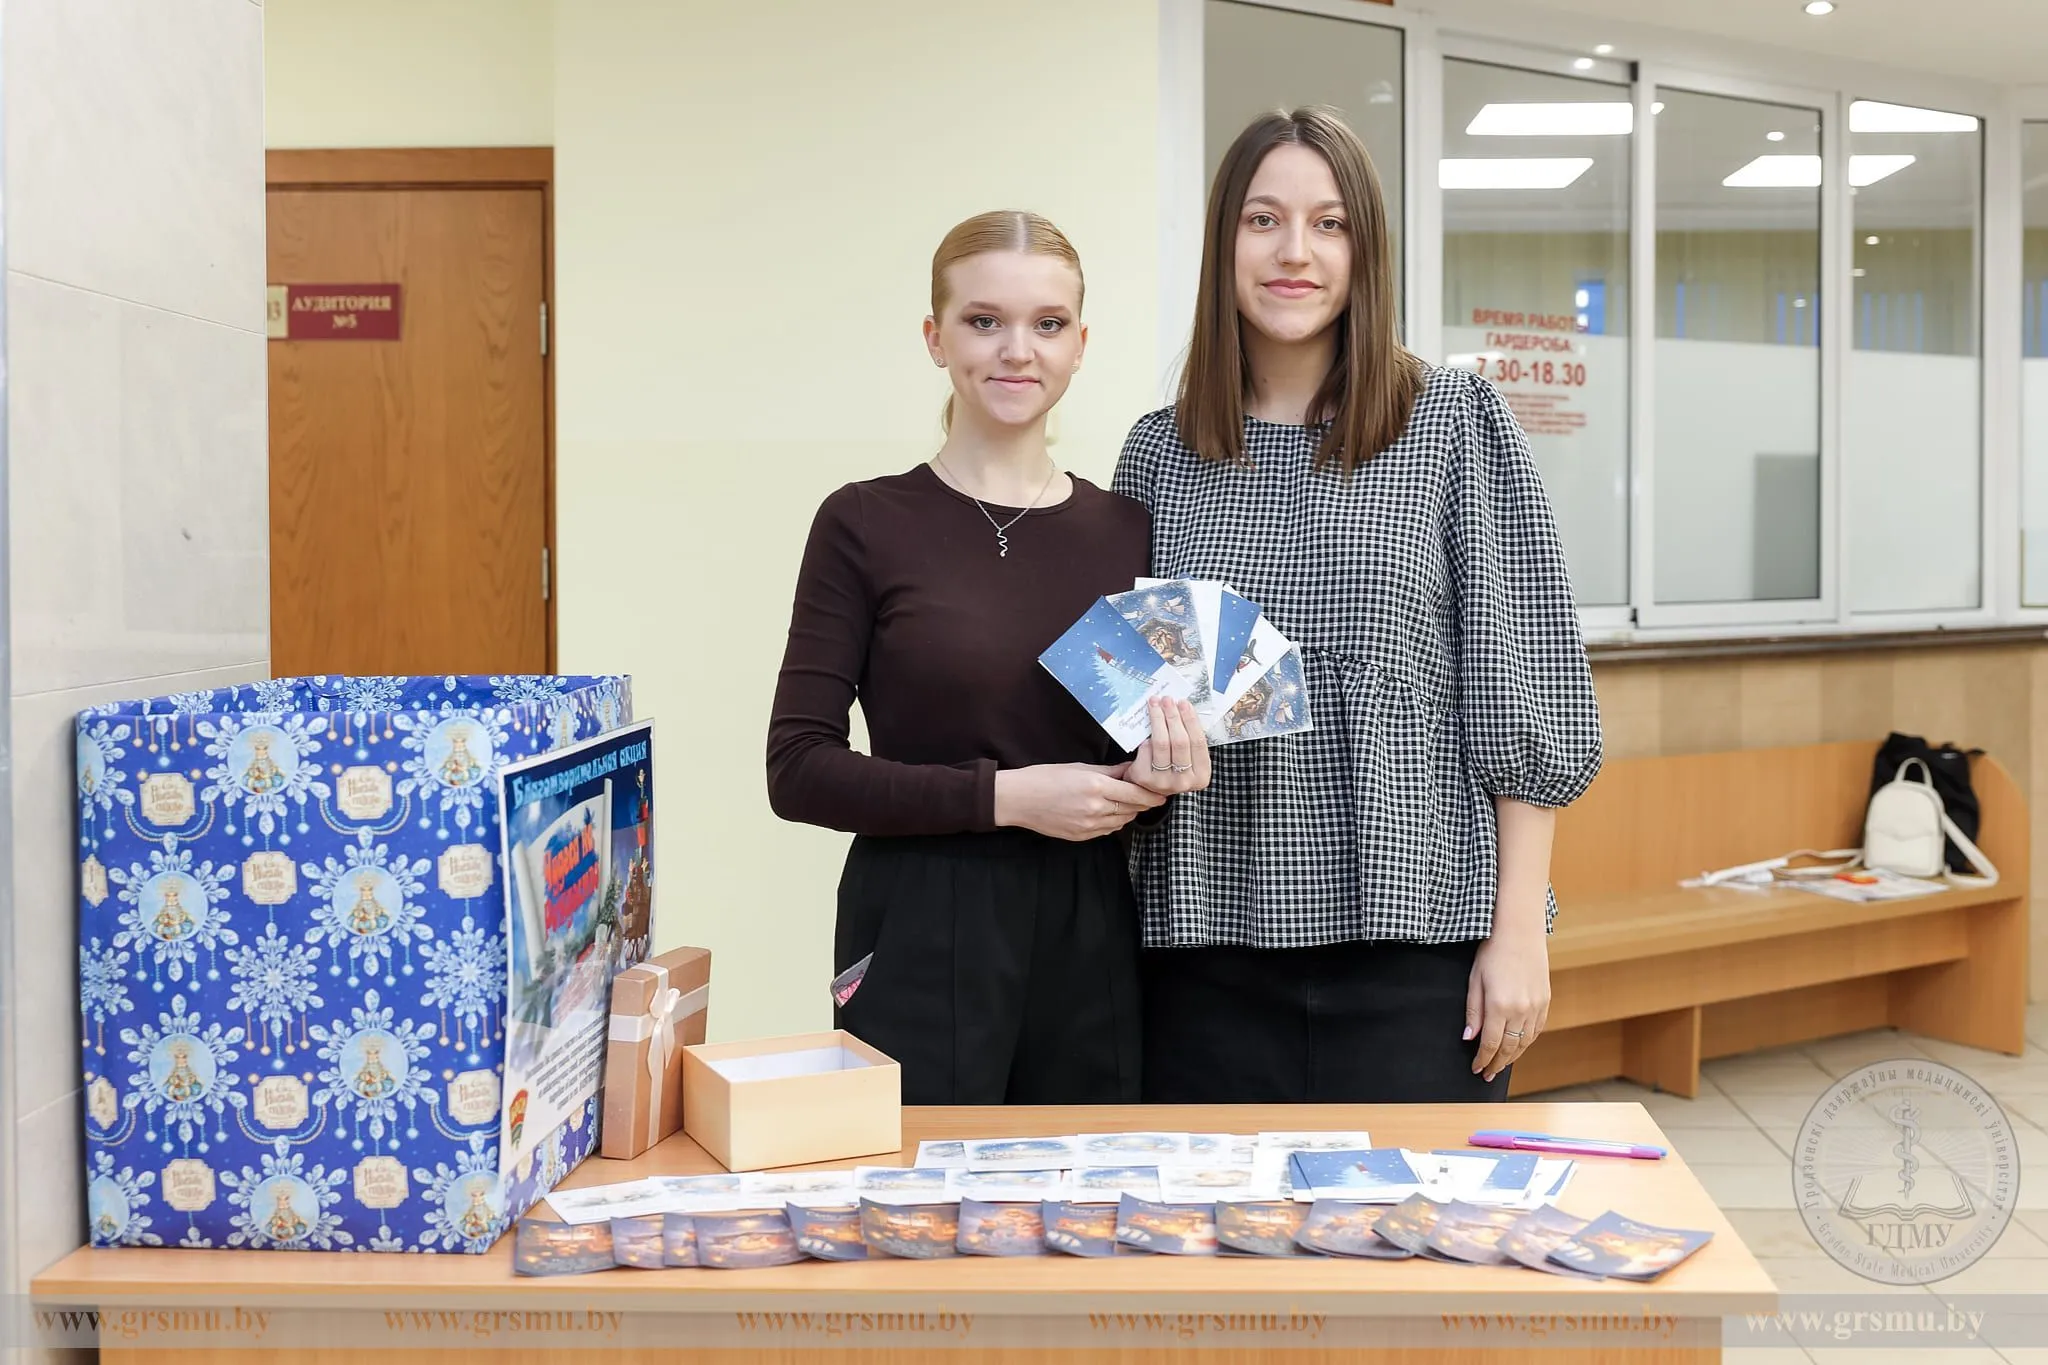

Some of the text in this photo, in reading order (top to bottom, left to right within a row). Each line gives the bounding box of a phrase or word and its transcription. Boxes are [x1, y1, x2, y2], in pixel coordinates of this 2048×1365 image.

[292, 295, 392, 312] АУДИТОРИЯ
[1472, 308, 1524, 328] ВРЕМЯ
[1476, 357, 1586, 386] 7.30-18.30
